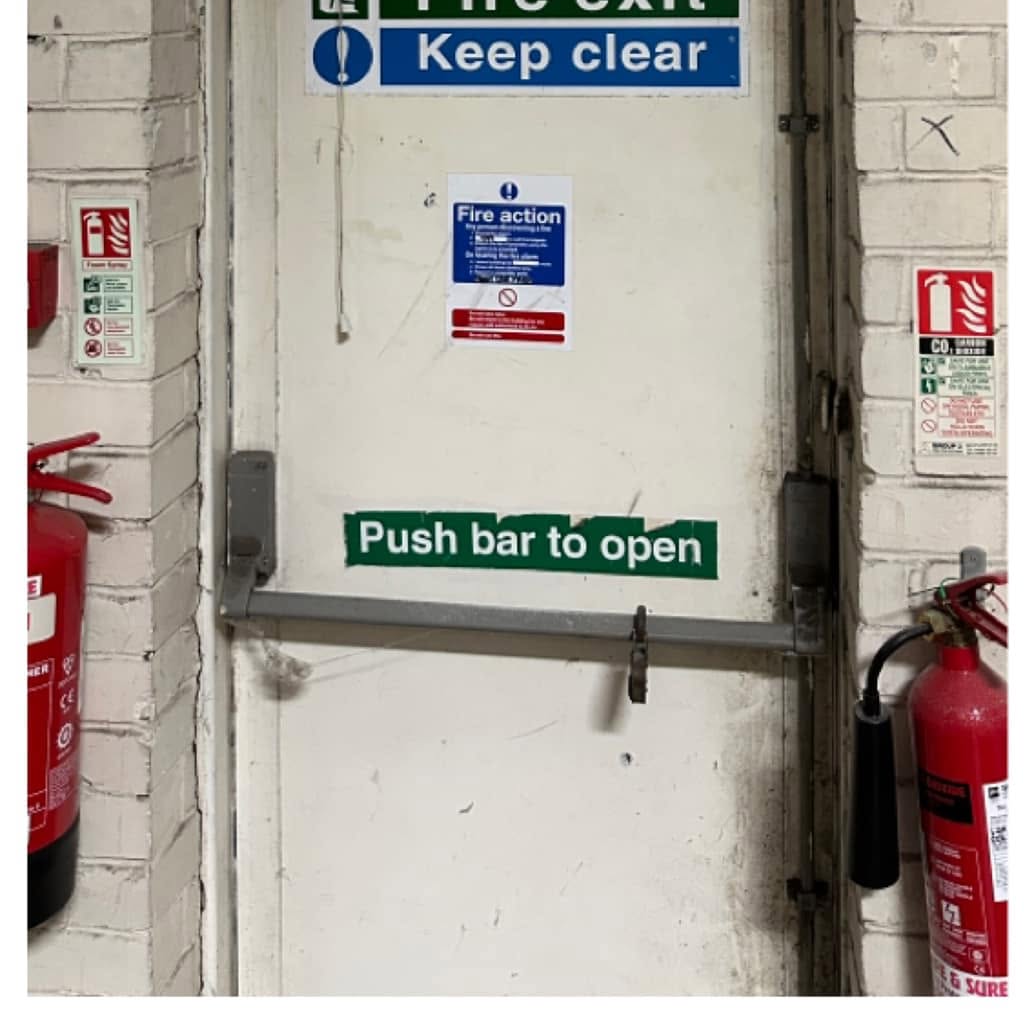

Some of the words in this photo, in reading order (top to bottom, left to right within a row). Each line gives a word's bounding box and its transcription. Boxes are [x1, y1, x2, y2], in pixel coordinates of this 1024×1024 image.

[418, 32, 550, 79] Keep
[571, 31, 706, 72] clear
[457, 206, 494, 223] Fire
[500, 208, 561, 224] action
[359, 520, 457, 555] Push
[472, 522, 536, 556] bar
[547, 526, 587, 559] to
[601, 533, 703, 569] open
[966, 977, 1008, 997] SURE
